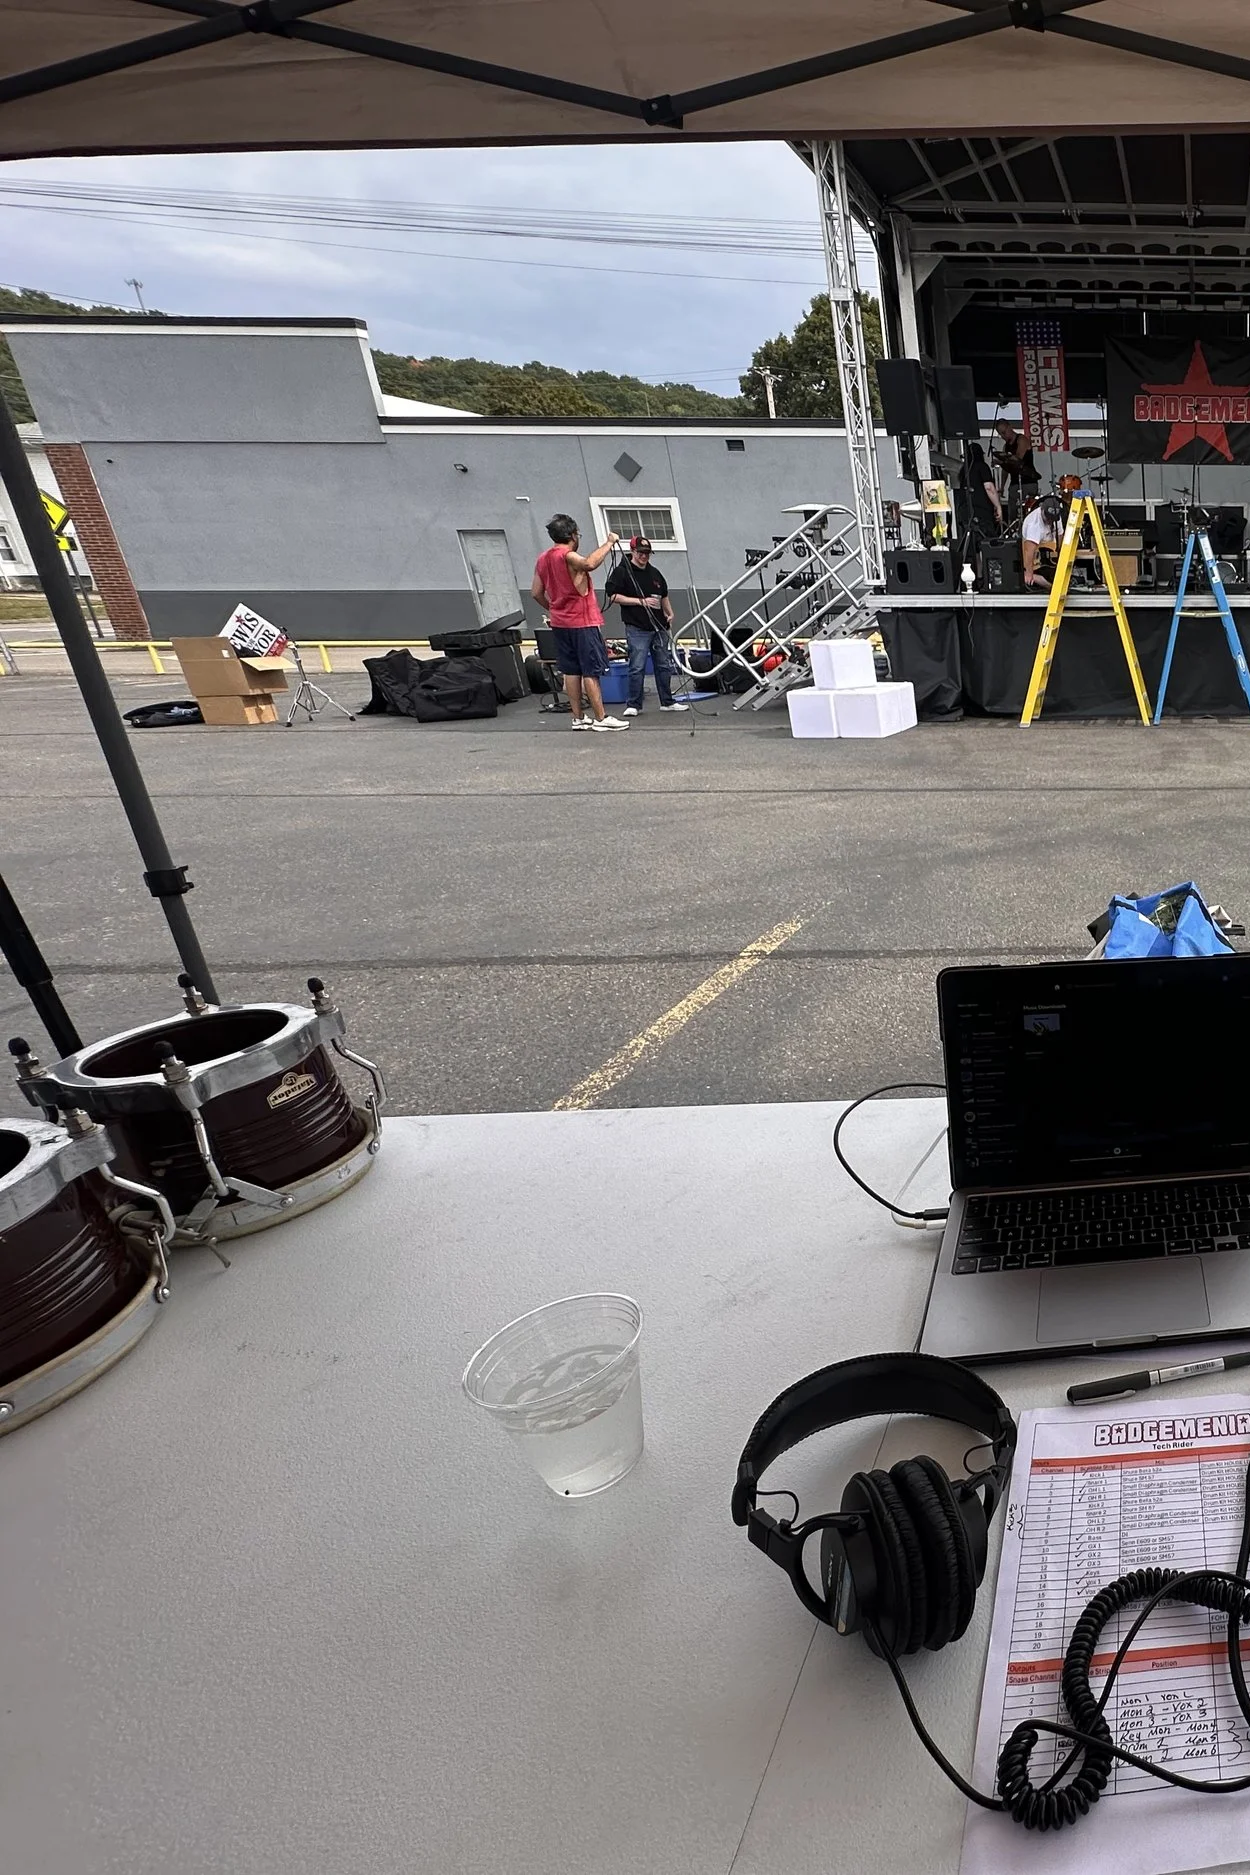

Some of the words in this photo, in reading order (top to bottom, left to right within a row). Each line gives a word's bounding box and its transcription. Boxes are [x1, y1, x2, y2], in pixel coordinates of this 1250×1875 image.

[1023, 349, 1037, 386] FOR
[1037, 349, 1065, 447] LEWIS
[1027, 390, 1041, 447] MAYOR
[229, 613, 259, 649] EWIS
[253, 629, 276, 656] YOR
[1172, 1441, 1194, 1449] Rider
[1029, 1673, 1057, 1681] Channel
[1151, 1660, 1177, 1668] Position
[1197, 1698, 1207, 1708] 2
